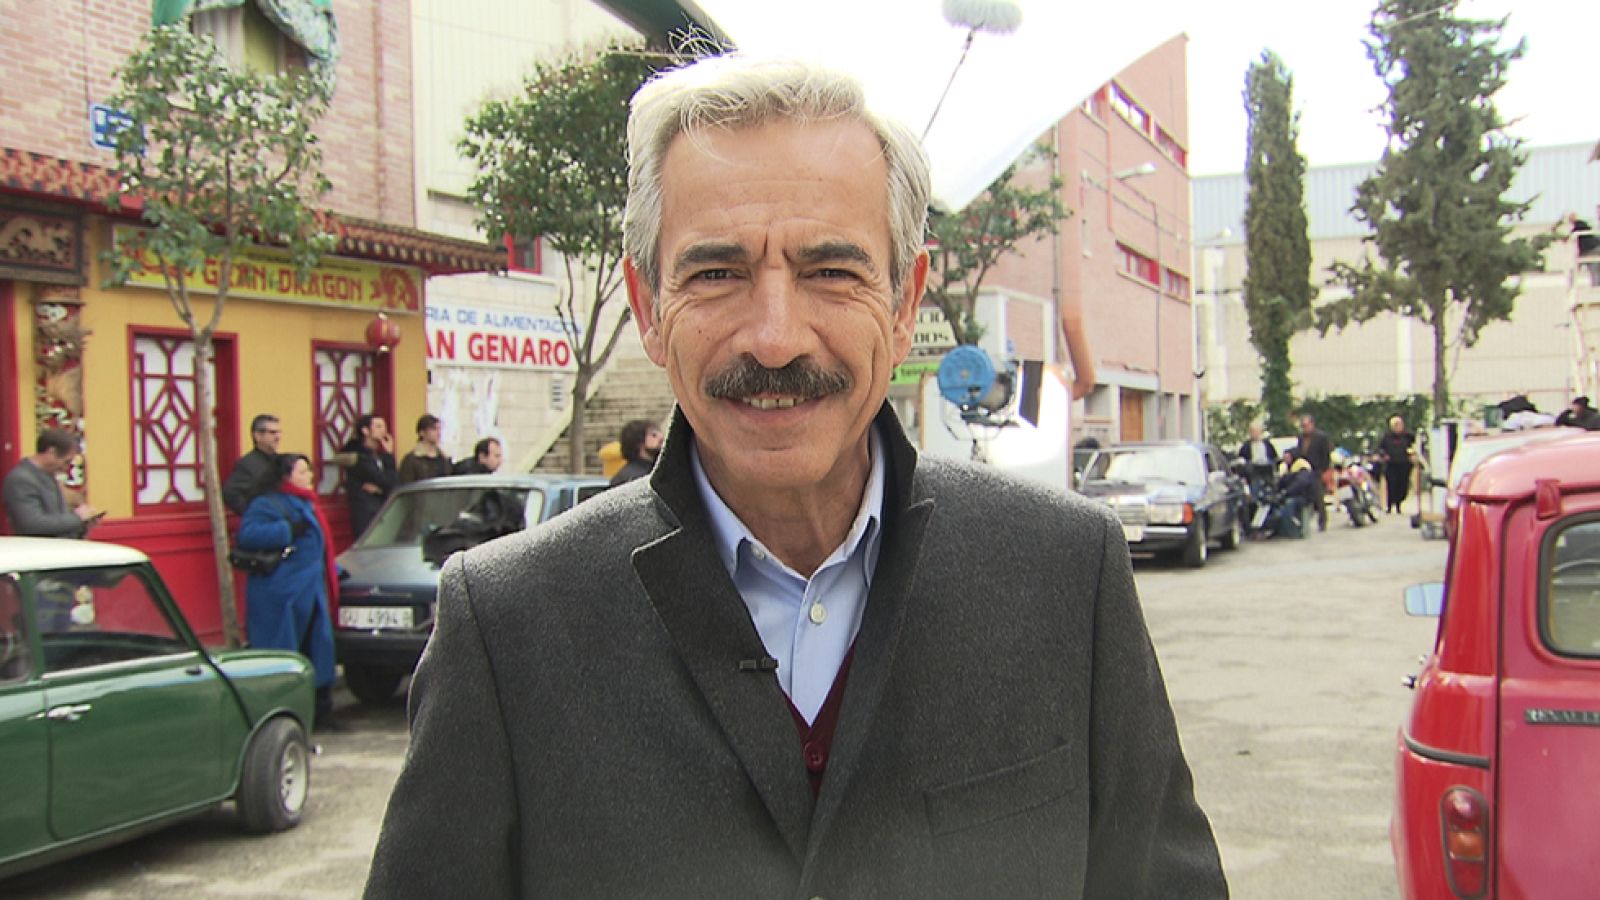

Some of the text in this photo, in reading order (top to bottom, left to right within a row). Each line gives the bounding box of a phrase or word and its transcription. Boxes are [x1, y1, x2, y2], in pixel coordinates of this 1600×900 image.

[277, 268, 363, 301] DRAGON
[457, 308, 478, 326] DE
[468, 332, 570, 367] GENARO
